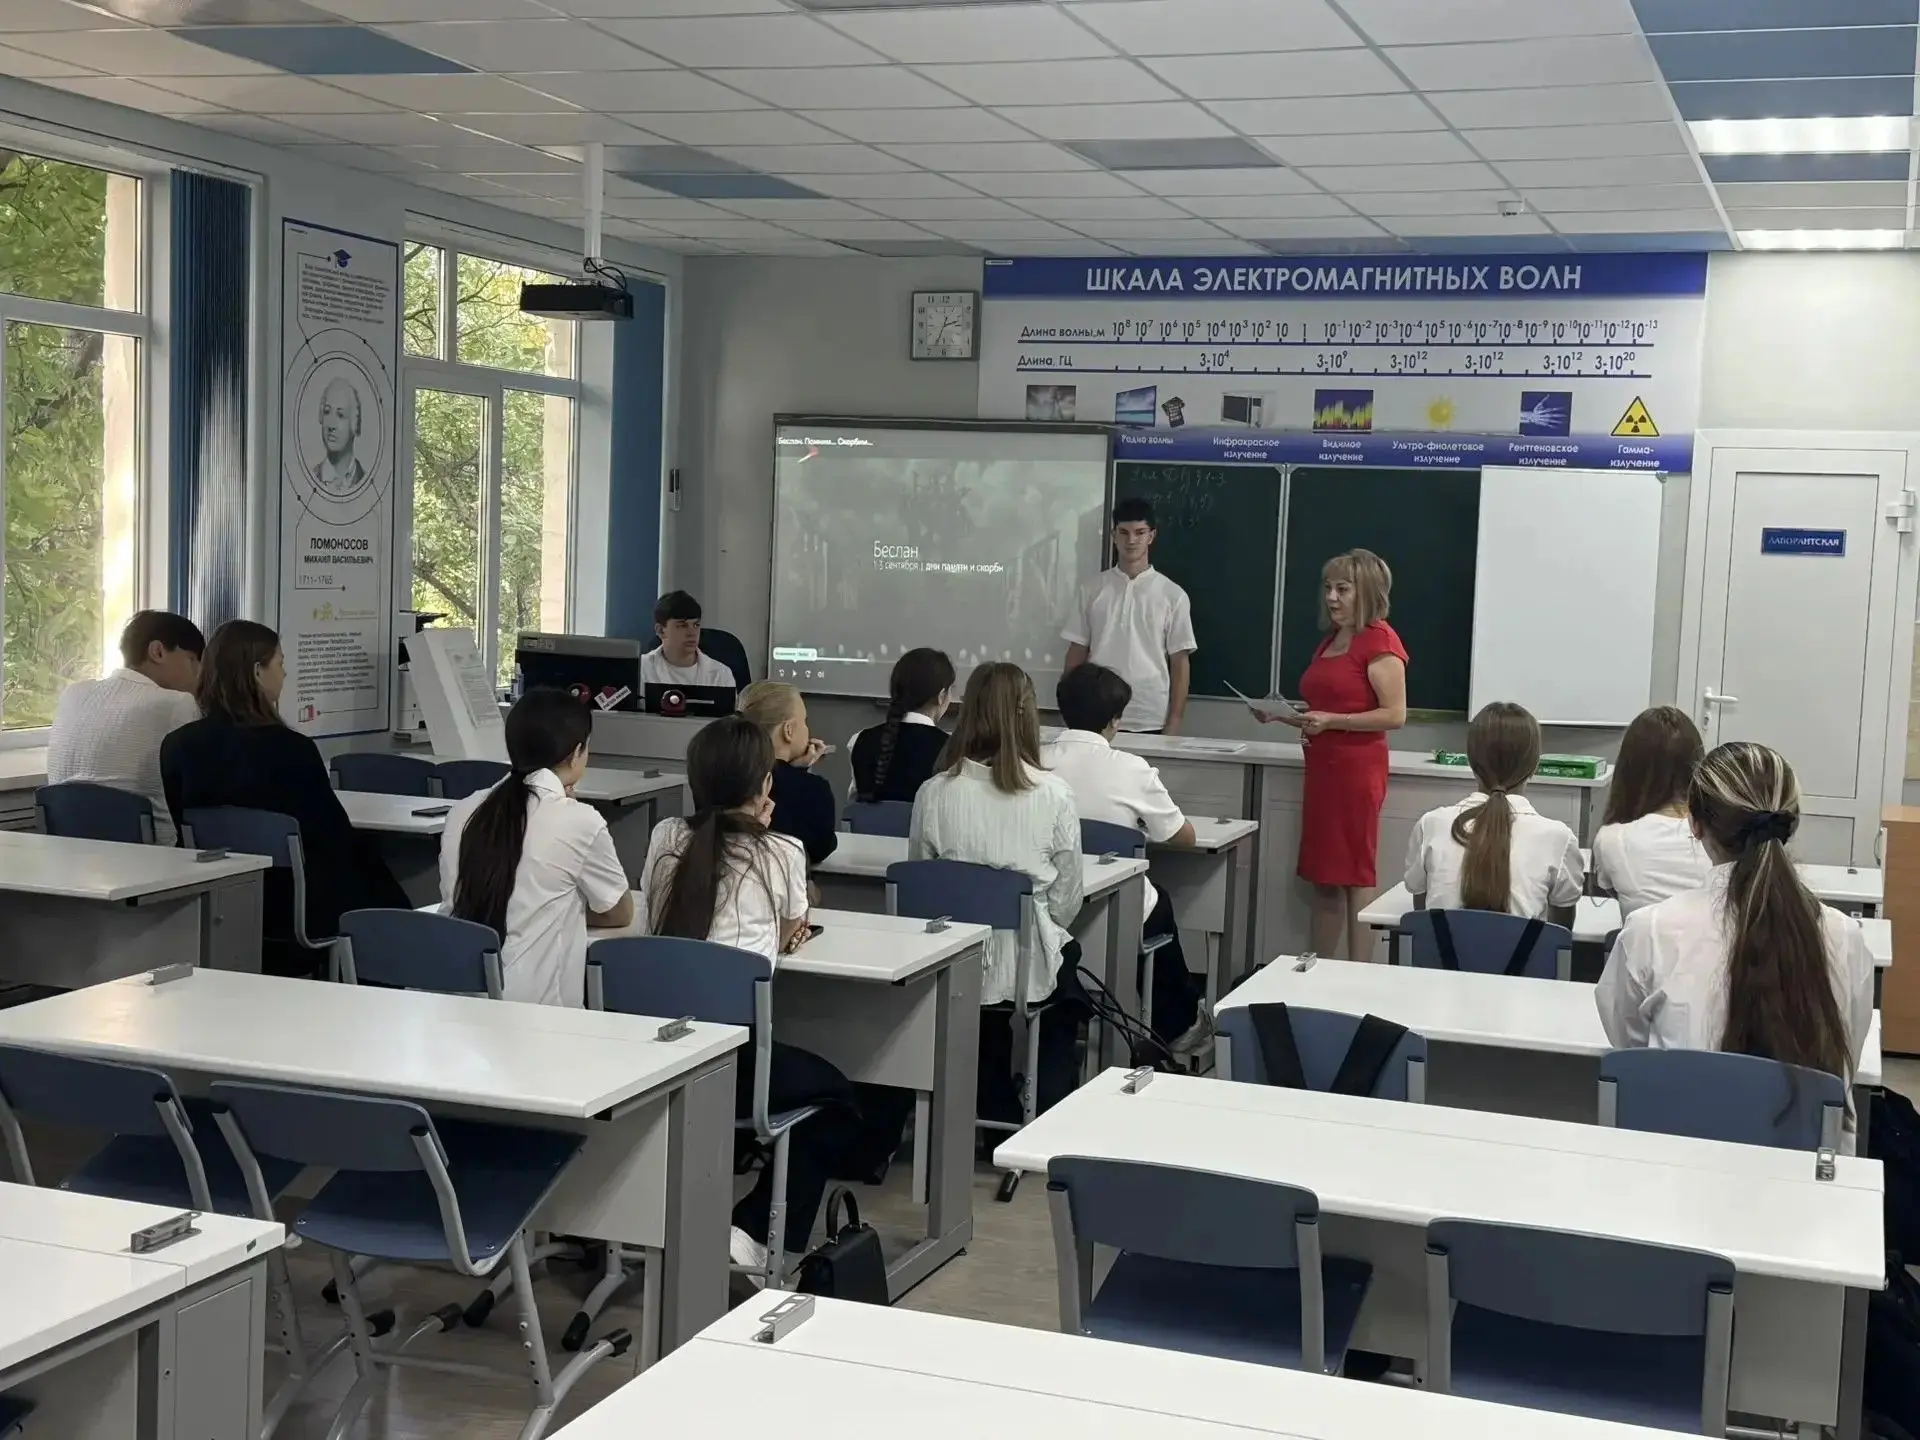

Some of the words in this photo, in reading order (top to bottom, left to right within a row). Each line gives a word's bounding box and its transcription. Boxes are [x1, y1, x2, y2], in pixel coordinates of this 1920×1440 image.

[1087, 268, 1184, 291] ШКАЛА
[1193, 267, 1489, 290] ЭЛЕКТРОМАГНИТНЫХ
[1499, 265, 1581, 290] ВОЛН
[1021, 326, 1055, 337] Длина
[1276, 323, 1288, 337] 10
[1059, 356, 1072, 367] ГЦ
[1322, 439, 1362, 449] Видимое
[1509, 443, 1579, 453] Рентгеновское
[1618, 444, 1654, 454] Гамма-
[1223, 451, 1268, 460] излучение
[1318, 454, 1363, 463] излучение
[1414, 455, 1461, 464] излучение
[1518, 457, 1567, 466] излучение
[1610, 459, 1660, 468] излучение
[310, 538, 369, 550] ЛОМОНОСОВ
[874, 540, 918, 558] Беслан
[304, 555, 331, 563] МИХАИЛ
[332, 555, 374, 563] ВАСИЛЬЕВИЧ
[926, 562, 940, 571] дни
[977, 562, 1003, 574] скорби
